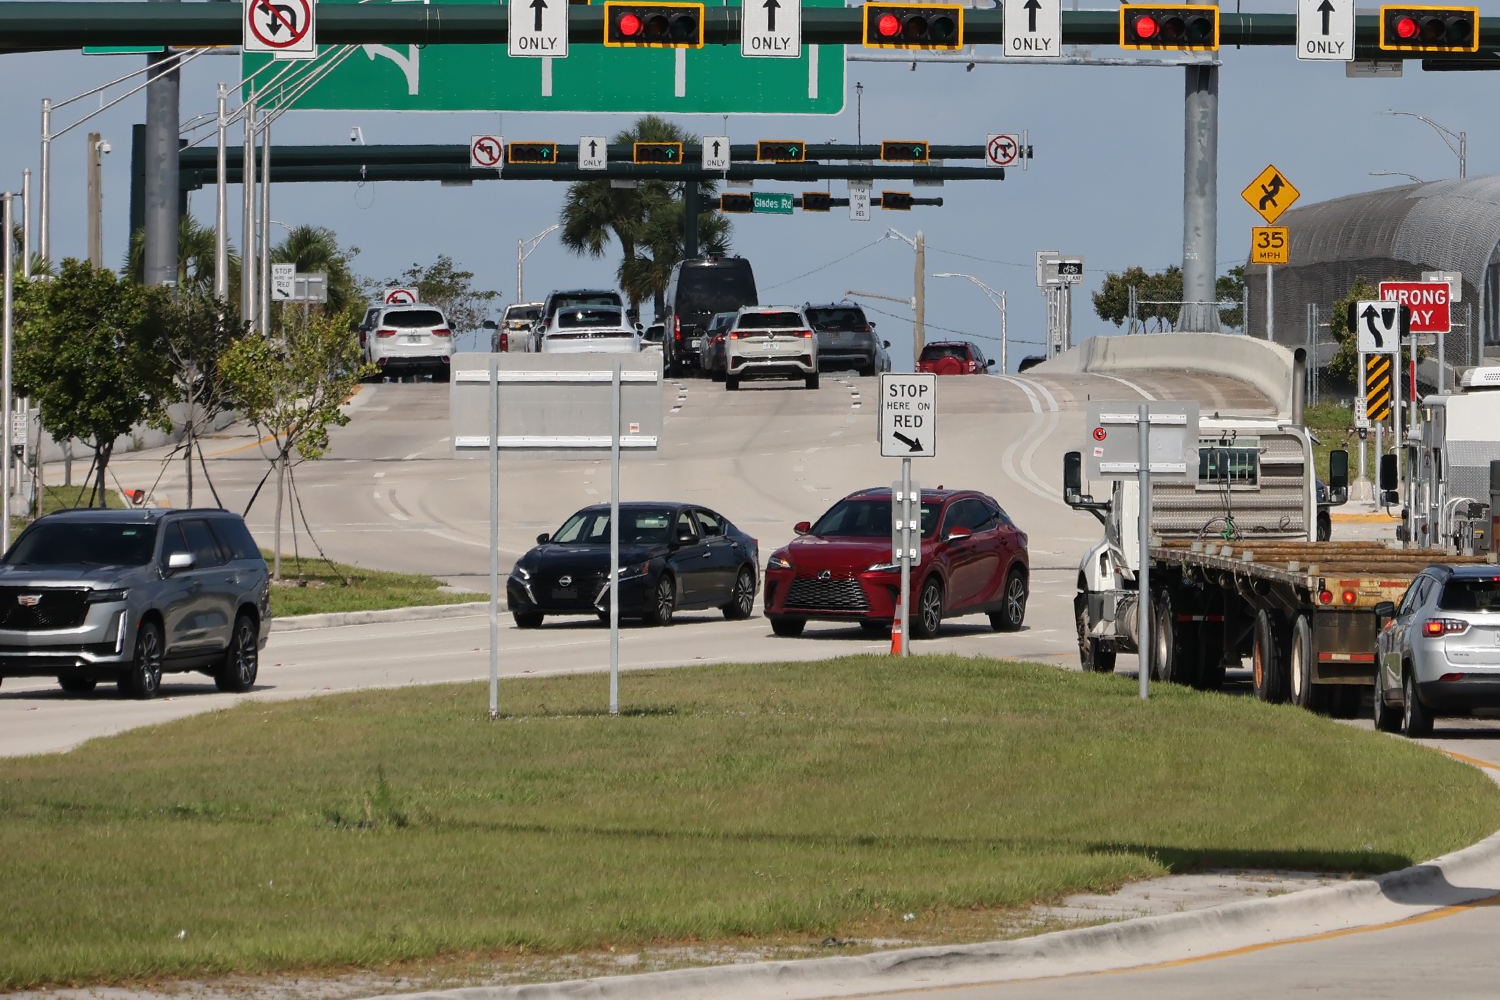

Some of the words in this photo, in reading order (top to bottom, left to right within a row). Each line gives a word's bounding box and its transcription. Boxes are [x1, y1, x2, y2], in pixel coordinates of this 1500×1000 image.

[518, 36, 557, 50] ONLY
[752, 37, 791, 51] ONLY
[1013, 37, 1051, 50] ONLY
[1306, 40, 1345, 54] ONLY
[584, 159, 602, 167] ONLY
[707, 159, 725, 167] ONLY
[754, 198, 779, 209] Glades
[781, 199, 791, 209] Rd
[1257, 231, 1284, 249] 35
[1383, 289, 1446, 306] WRONG
[1409, 310, 1434, 326] AY
[889, 384, 929, 398] STOP
[886, 401, 911, 410] HERE
[917, 402, 931, 411] ON
[893, 414, 923, 428] RED
